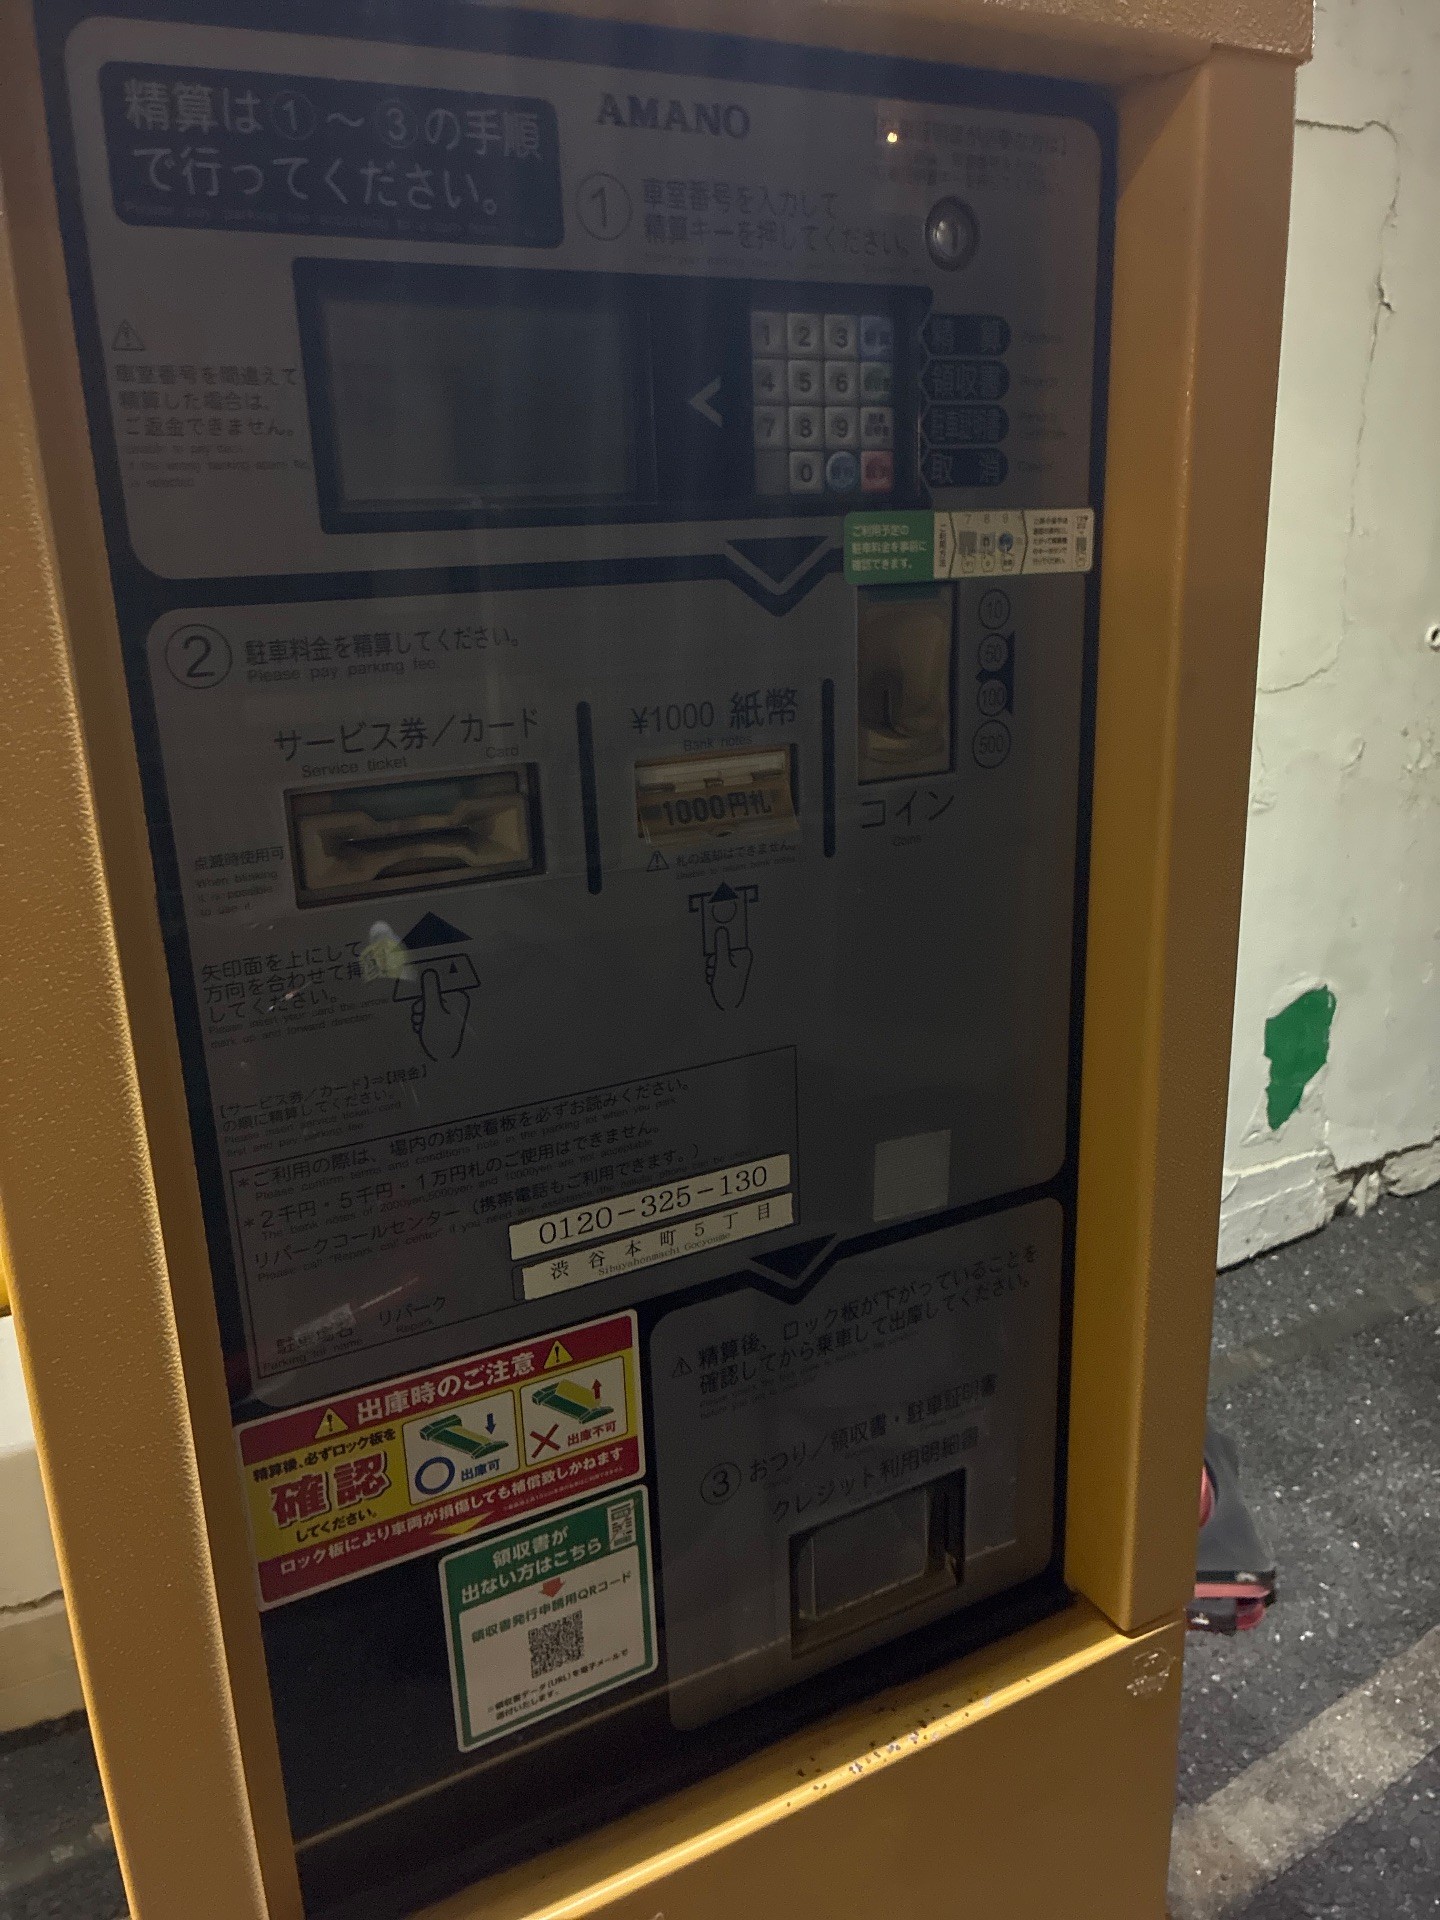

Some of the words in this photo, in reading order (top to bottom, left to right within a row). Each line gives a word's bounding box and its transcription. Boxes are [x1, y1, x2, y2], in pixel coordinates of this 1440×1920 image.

[595, 93, 751, 141] AMANO
[133, 146, 497, 216] で行ってください。
[798, 325, 811, 347] 2
[835, 326, 849, 349] 3
[761, 372, 776, 393] 4
[801, 371, 812, 393] 5
[836, 372, 849, 394] 6
[762, 415, 776, 438] 7
[801, 417, 813, 439] 8
[836, 418, 849, 439] 9
[800, 463, 813, 483] 0
[244, 626, 520, 666] 駐車料金を精算してください。
[247, 666, 300, 684] Please
[310, 665, 338, 682] pay
[348, 660, 405, 677] parking
[631, 701, 716, 736] ¥1000
[729, 687, 798, 731] 紙幣
[302, 760, 359, 778] Service
[367, 756, 408, 771] ticket
[486, 744, 519, 760] Card
[683, 736, 714, 752] Bank
[720, 735, 752, 748] notes
[662, 789, 773, 826] 1000円札
[861, 789, 956, 830] コイン
[202, 940, 363, 983] 矢印面を上にして
[204, 961, 364, 1004] 方向を合わせて挿
[208, 988, 338, 1024] してください。
[255, 1186, 295, 1201] Please
[301, 1174, 345, 1192] confirm
[388, 1159, 409, 1172] and
[415, 1145, 471, 1165] conditions
[476, 1138, 500, 1151] note
[520, 1128, 537, 1140] the
[542, 1119, 580, 1137] parking
[603, 1108, 629, 1121] when
[325, 1212, 356, 1226] notes
[478, 1177, 499, 1189] and
[539, 1166, 768, 1246] 0120-325-130
[550, 1202, 772, 1281] 渋谷本町5丁目
[379, 1296, 447, 1327] リパーク
[357, 1350, 535, 1424] 出庫時のご注意
[567, 1419, 617, 1448] 出庫不可
[253, 1427, 397, 1484] 精算後、必ずロック板を
[461, 1457, 501, 1483] 出庫可
[270, 1451, 391, 1529] 確認
[280, 1446, 624, 1576] ロック板により車両が損傷しても補償致しかねます
[295, 1506, 378, 1543] してください。
[492, 1525, 570, 1570] 領収書が
[461, 1538, 602, 1604] 出ない方はこちら
[471, 1570, 633, 1643] 領収書発行申請用QRコード
